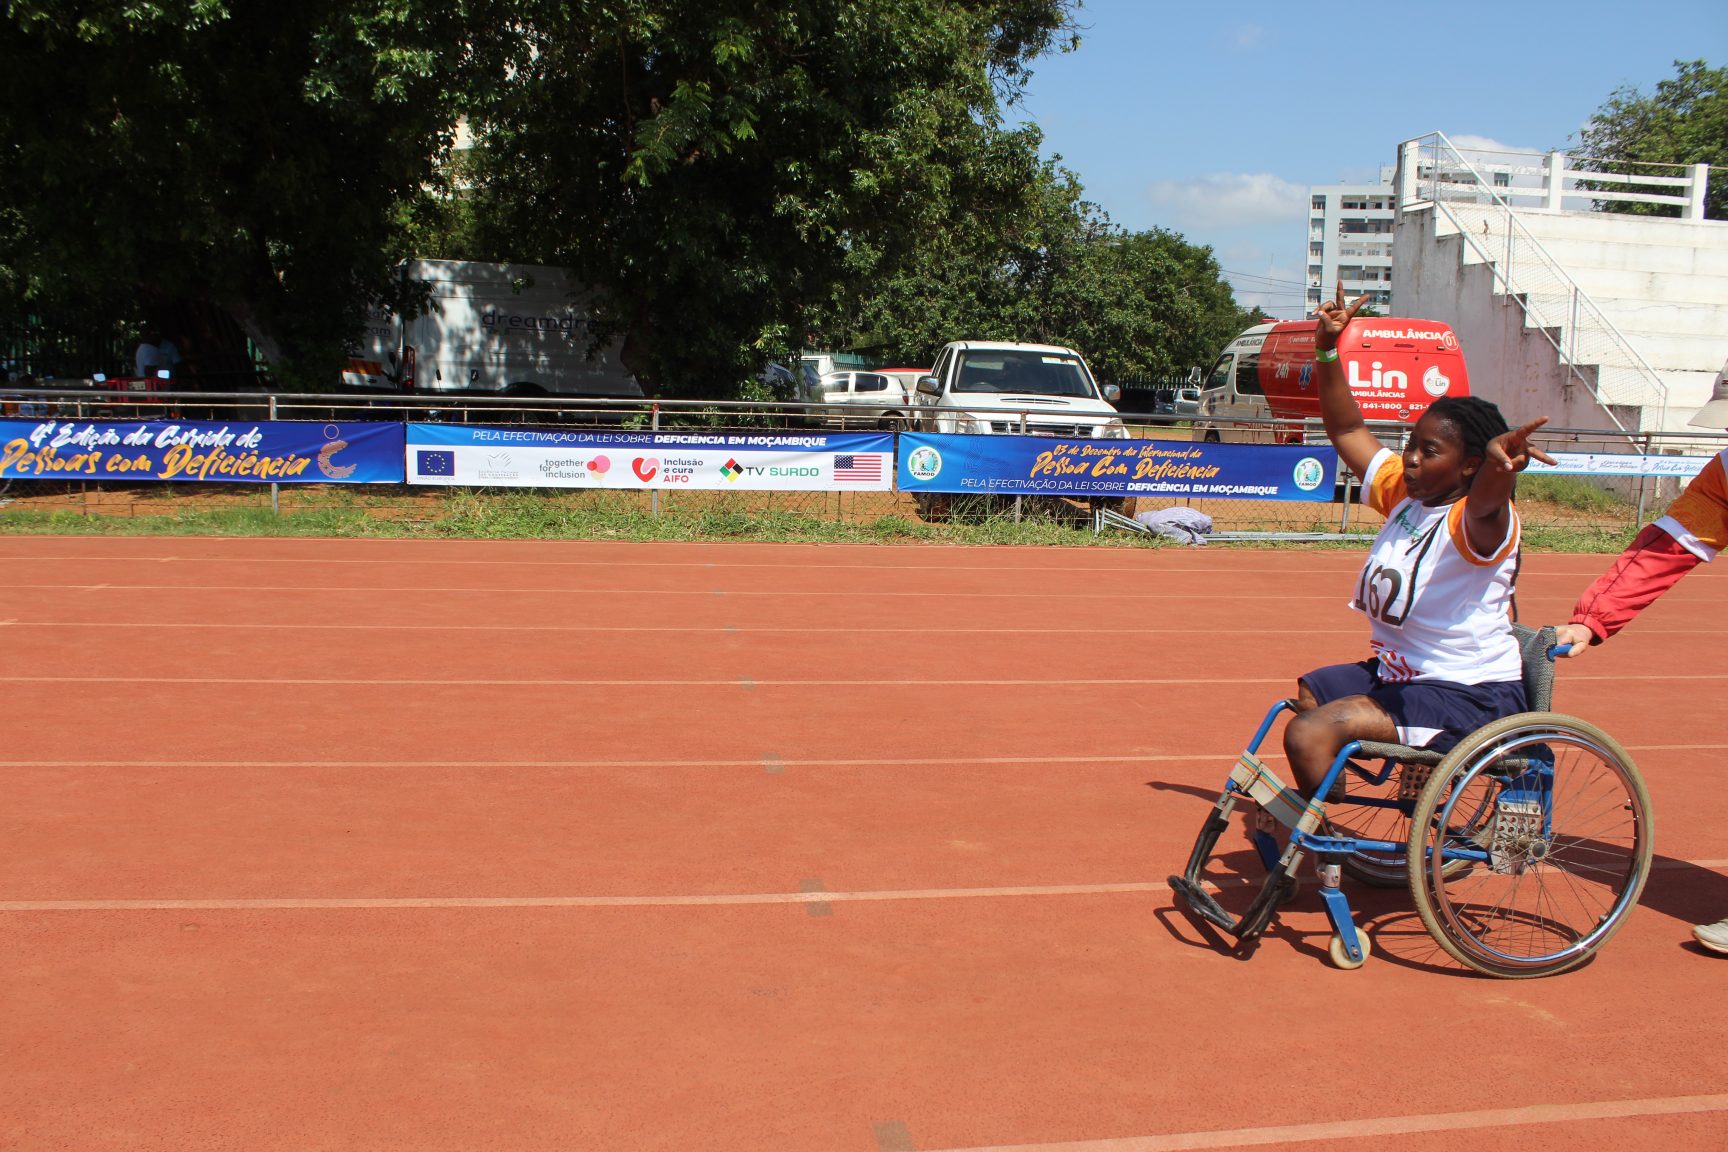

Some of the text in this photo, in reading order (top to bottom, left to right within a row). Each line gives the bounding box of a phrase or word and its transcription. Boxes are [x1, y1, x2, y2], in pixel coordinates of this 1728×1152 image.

[482, 309, 600, 331] dreamdre
[1362, 328, 1457, 347] AMBULÂNCIA 01
[1348, 360, 1408, 389] Lin
[1362, 402, 1402, 410] 841-1800
[50, 422, 121, 451] Edição
[122, 425, 154, 446] da
[154, 425, 236, 449] Corrida
[235, 426, 263, 448] de
[472, 430, 827, 448] PELA EFECTIVAÇÃO DA LEI SOBRE DEFICIÊNCIA EM MOÇAMBIQUE
[0, 438, 311, 480] Pessoas com Deficiência
[1080, 444, 1121, 457] Dezembro
[1138, 443, 1193, 460] Internacional
[539, 463, 552, 472] for
[545, 459, 584, 468] together
[663, 457, 704, 467] Inclusão
[1030, 451, 1220, 481] Pessoa Com Deficiência
[545, 470, 586, 479] inclusion
[663, 475, 689, 483] AIFO
[745, 466, 820, 477] TV SURDO
[960, 478, 1278, 495] PELA EFECTIVAÇÃO DA LEI SOBRE DEFICIÊNCIA EM MOÇAMBIQUE
[1355, 560, 1402, 626] 162
